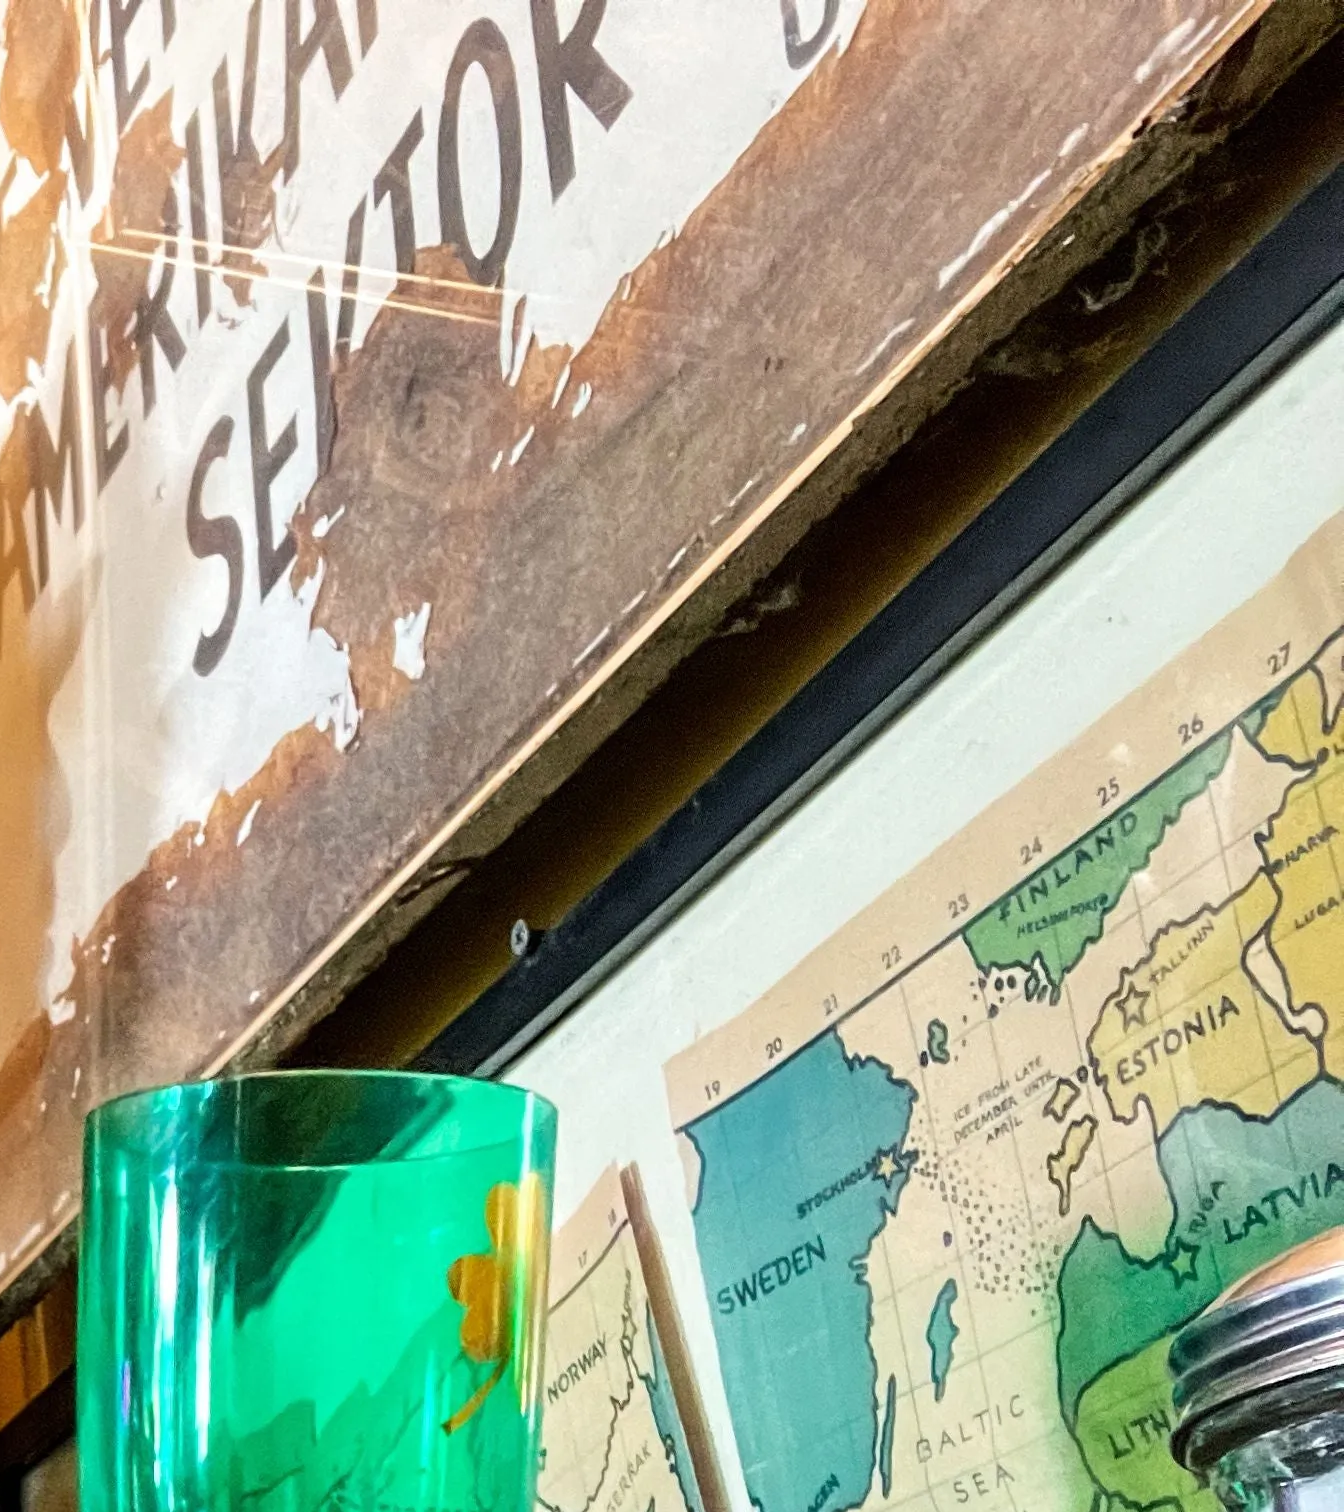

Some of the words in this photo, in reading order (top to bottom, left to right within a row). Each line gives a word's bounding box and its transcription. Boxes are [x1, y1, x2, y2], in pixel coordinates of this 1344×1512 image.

[1267, 641, 1291, 675] 27
[1177, 713, 1204, 745] 26
[1096, 777, 1120, 806] 25
[998, 811, 1138, 925] FINLAND
[1020, 836, 1043, 864] 24
[948, 894, 970, 919] 23
[882, 945, 902, 970] 22
[1149, 919, 1215, 984] TALLINN
[765, 1036, 783, 1059] 20
[1116, 995, 1240, 1086] ESTONIA
[704, 1080, 721, 1100] 19
[954, 1107, 972, 1123] ICE
[978, 1080, 1010, 1104] FROM
[1016, 1056, 1043, 1081] LATE
[954, 1097, 1019, 1144] DECEMBER
[986, 1117, 1024, 1144] APRIL
[1223, 1162, 1344, 1244] LATVIA
[716, 1233, 827, 1315] SWEDEN
[547, 1332, 609, 1404] NORWAY
[916, 1393, 1025, 1464] BALTIC
[953, 1463, 1016, 1503] SEA
